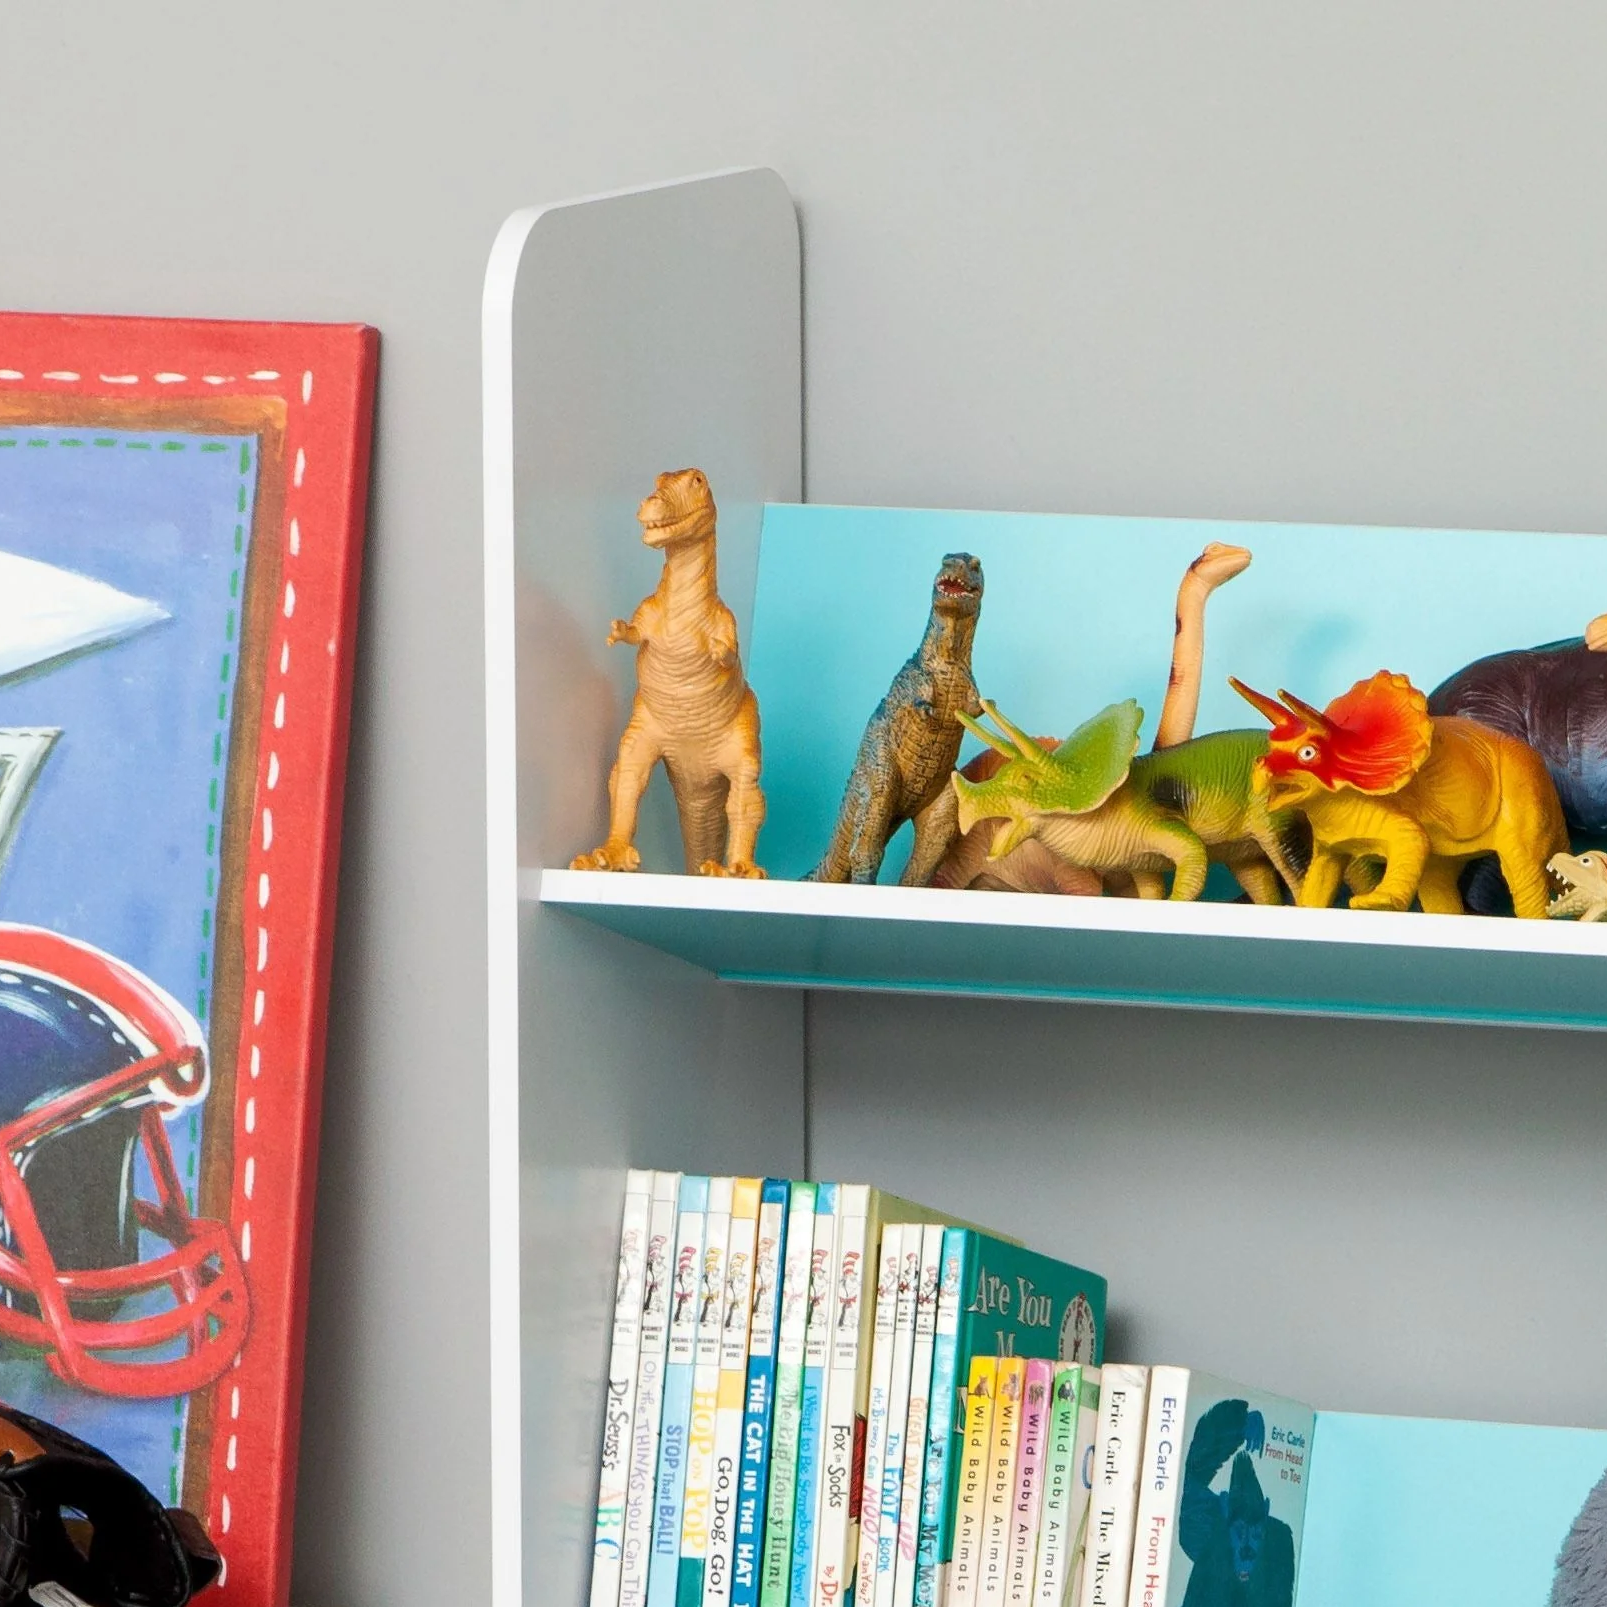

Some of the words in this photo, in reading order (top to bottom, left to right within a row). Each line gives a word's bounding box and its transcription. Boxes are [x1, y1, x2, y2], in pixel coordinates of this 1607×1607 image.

[966, 1266, 1011, 1316] Are
[1017, 1276, 1053, 1328] You
[749, 1375, 767, 1414] THE
[1110, 1390, 1126, 1428] Eric
[1161, 1396, 1177, 1433] Eric
[689, 1391, 718, 1455] HOP
[745, 1422, 764, 1464] CAT
[831, 1424, 851, 1451] Fox
[869, 1408, 885, 1449] Brown
[970, 1405, 986, 1447] Wild
[1000, 1404, 1014, 1448] Wild
[1025, 1413, 1040, 1456] Wild
[1056, 1410, 1071, 1453] Wild
[1271, 1426, 1285, 1442] Eric
[1287, 1431, 1305, 1448] Carle
[629, 1419, 650, 1491] THINKS
[664, 1424, 683, 1469] STOP
[866, 1455, 879, 1480] Can
[1104, 1436, 1122, 1486] Carle
[1154, 1440, 1172, 1491] Carle
[1265, 1442, 1284, 1460] From
[1285, 1448, 1303, 1466] Head
[661, 1472, 676, 1501] That
[743, 1470, 757, 1492] IN
[827, 1464, 847, 1508] Socks
[902, 1455, 919, 1490] DAY
[963, 1458, 980, 1504] Baby
[992, 1458, 1009, 1503] Baby
[1018, 1467, 1035, 1512] Baby
[1048, 1464, 1066, 1509] Baby
[1280, 1468, 1288, 1480] to
[1289, 1468, 1302, 1484] Toe
[739, 1498, 755, 1535] THE
[768, 1466, 793, 1531] Honey
[924, 1477, 943, 1514] You
[656, 1505, 677, 1556] BALL!
[683, 1487, 709, 1550] POP
[710, 1495, 730, 1546] Dog.
[795, 1480, 812, 1558] Somebody
[918, 1523, 939, 1557] My
[1099, 1507, 1116, 1542] The
[767, 1535, 787, 1588] Hunt
[957, 1515, 974, 1592] Animals
[986, 1515, 1004, 1592] Animals
[1012, 1524, 1029, 1600] Animals
[1042, 1521, 1061, 1598] Animals
[1146, 1516, 1166, 1566] From
[708, 1554, 726, 1596] Go!
[735, 1544, 754, 1588] HAT
[791, 1563, 807, 1600] New!
